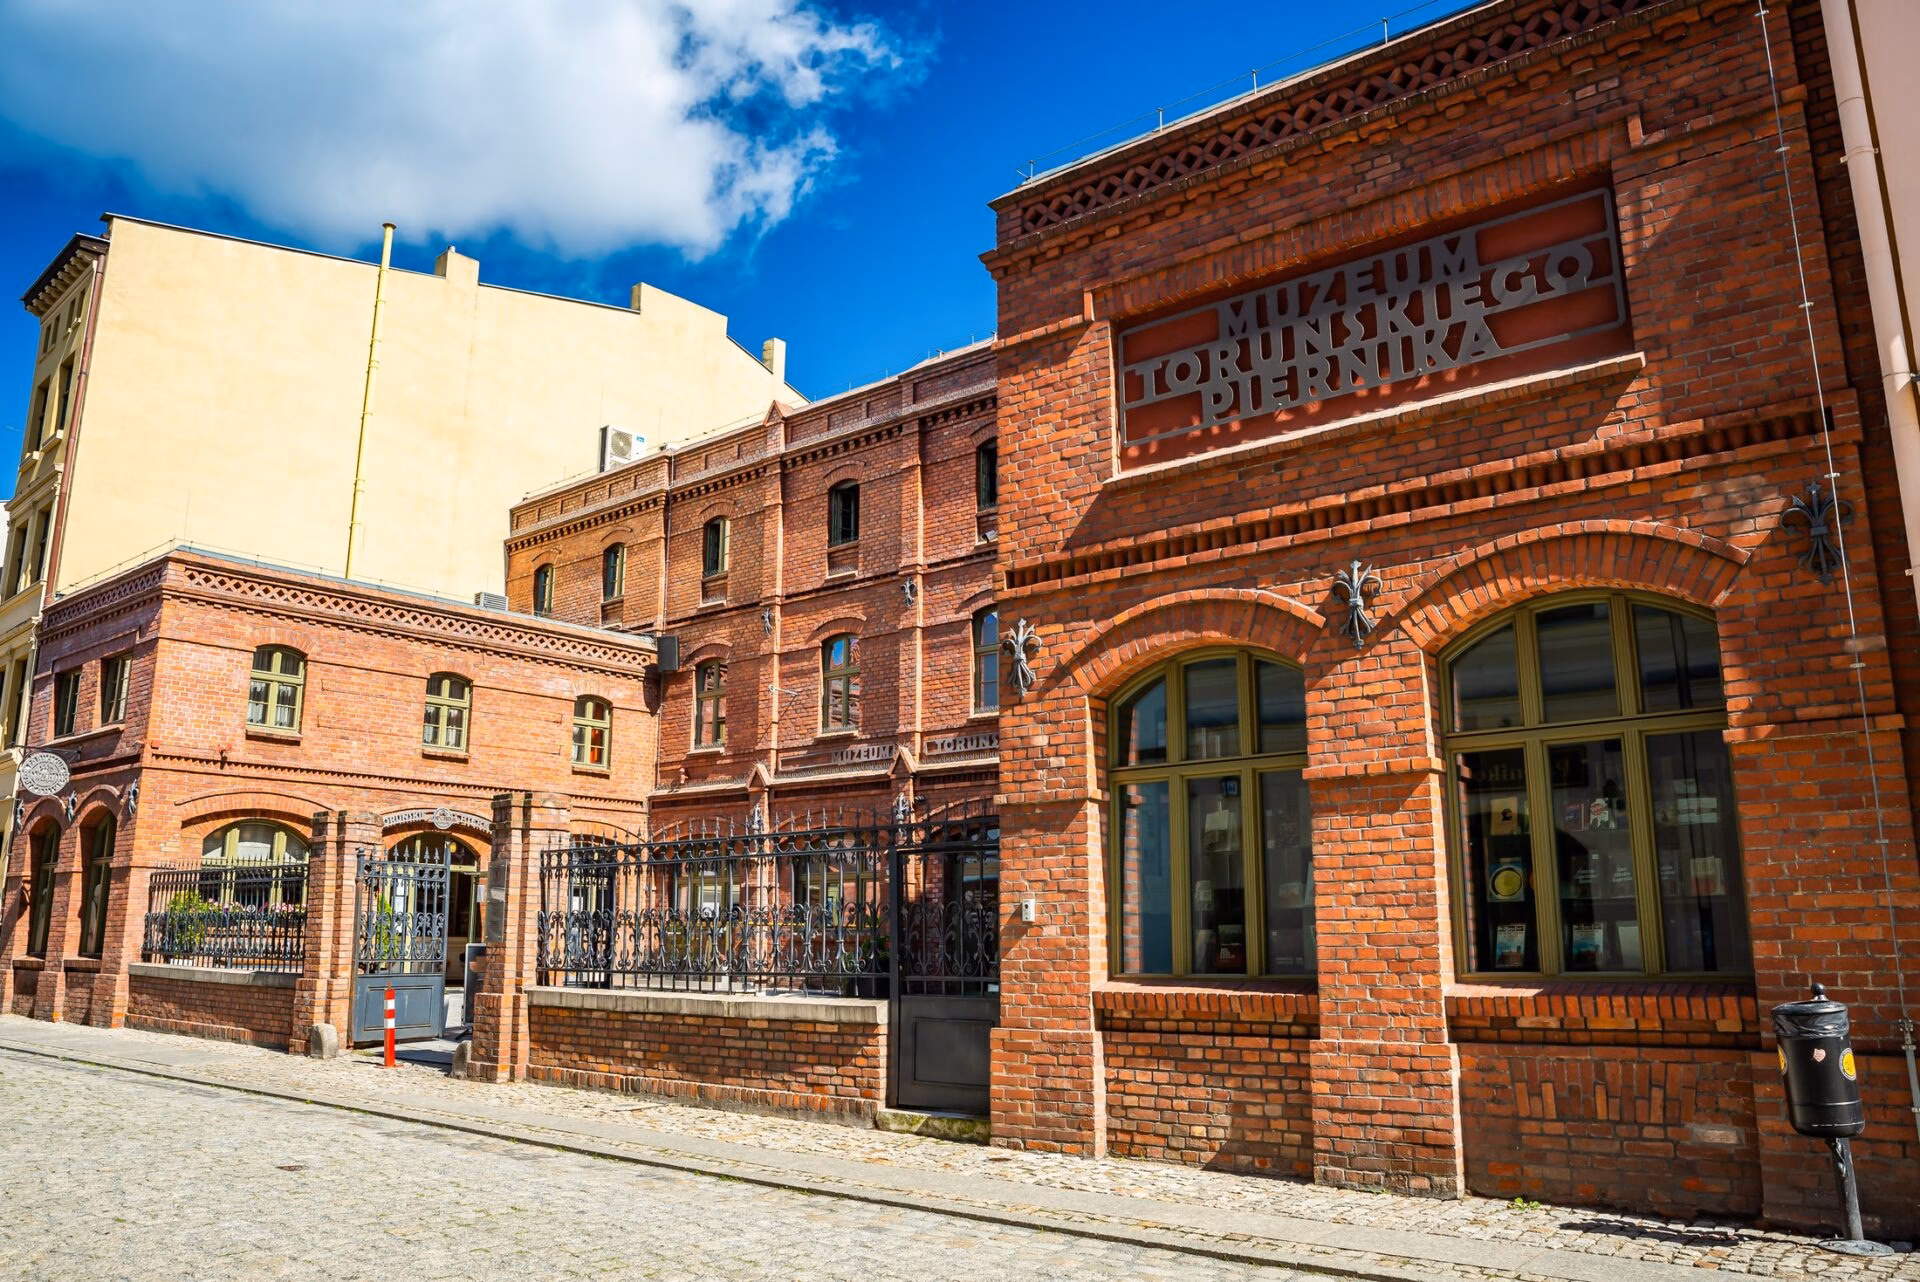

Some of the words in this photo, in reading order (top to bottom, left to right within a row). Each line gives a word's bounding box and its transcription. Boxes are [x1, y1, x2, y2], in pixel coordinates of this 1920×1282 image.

[1218, 230, 1476, 341] MUZEUM
[1202, 313, 1501, 428] PIERNIKA
[831, 745, 890, 764] MUZEUM
